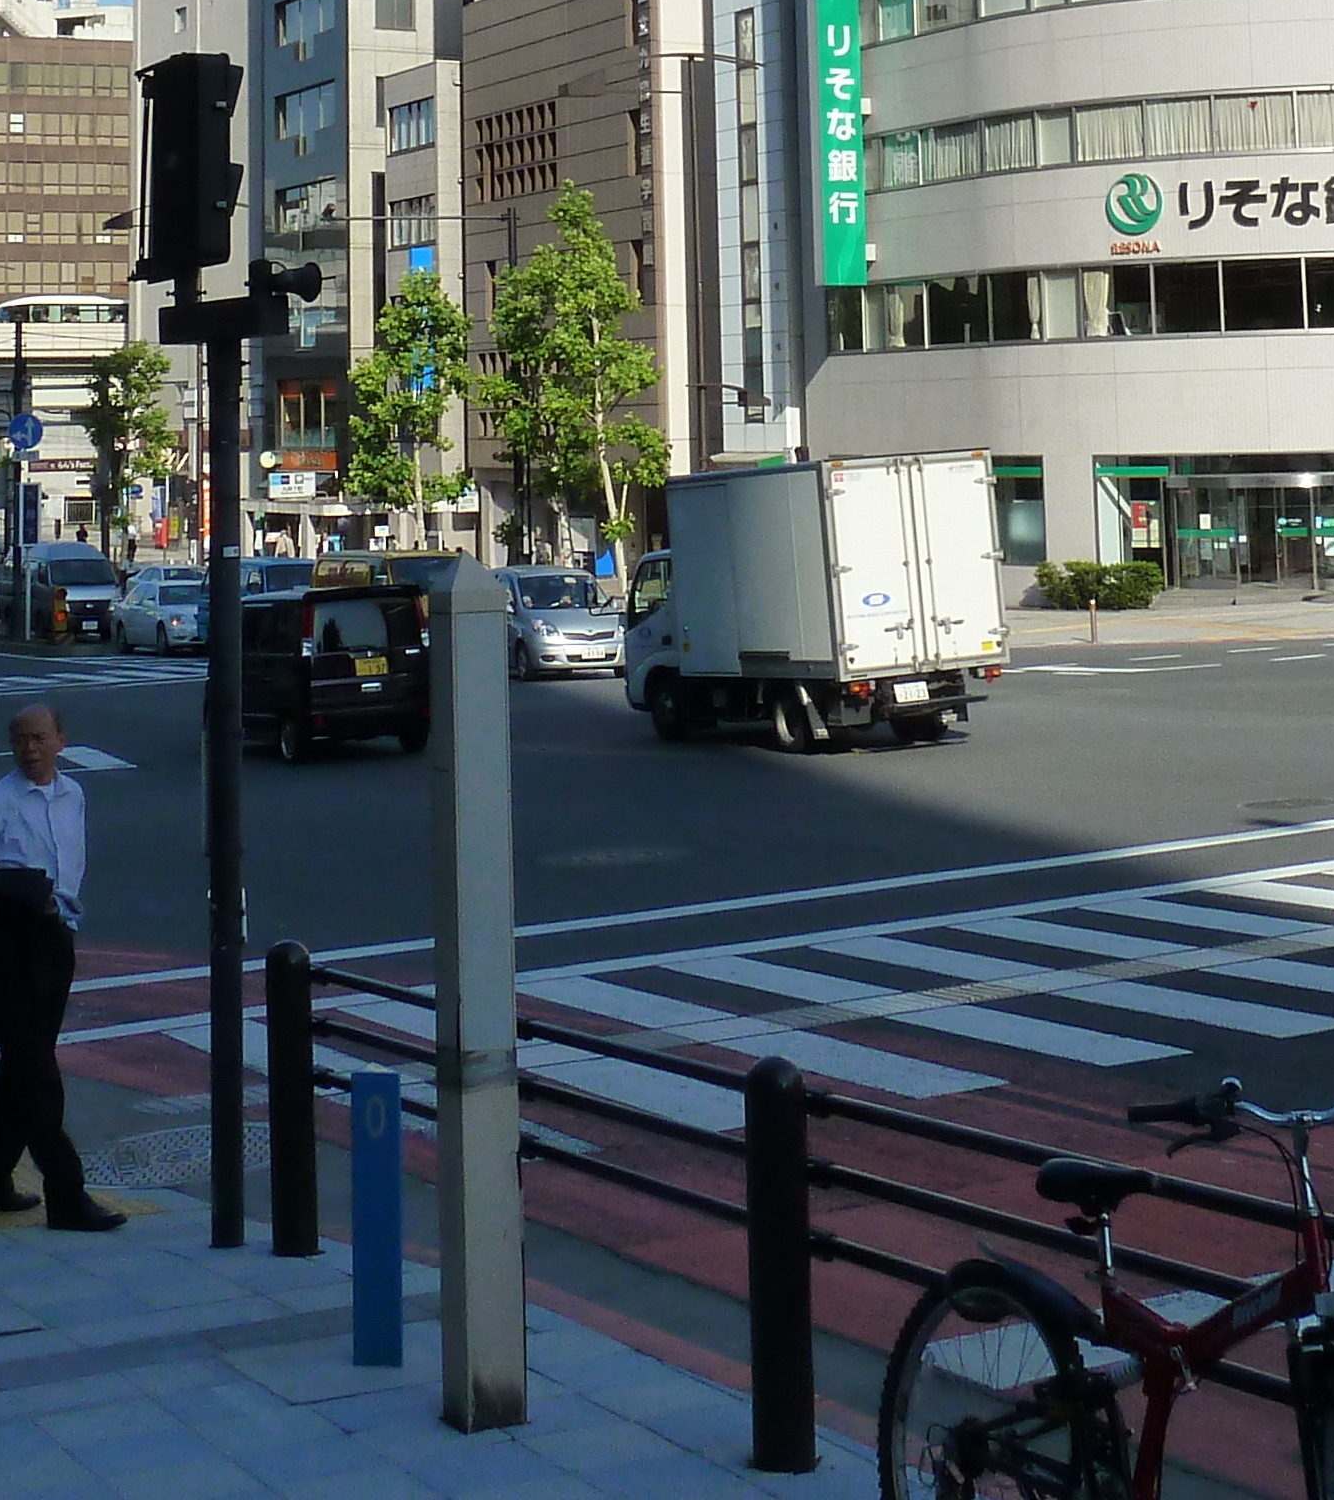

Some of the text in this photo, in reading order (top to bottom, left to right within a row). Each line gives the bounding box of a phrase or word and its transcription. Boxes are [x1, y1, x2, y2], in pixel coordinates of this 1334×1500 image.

[825, 25, 858, 225] りそな銀行
[1110, 240, 1160, 255] RESONA
